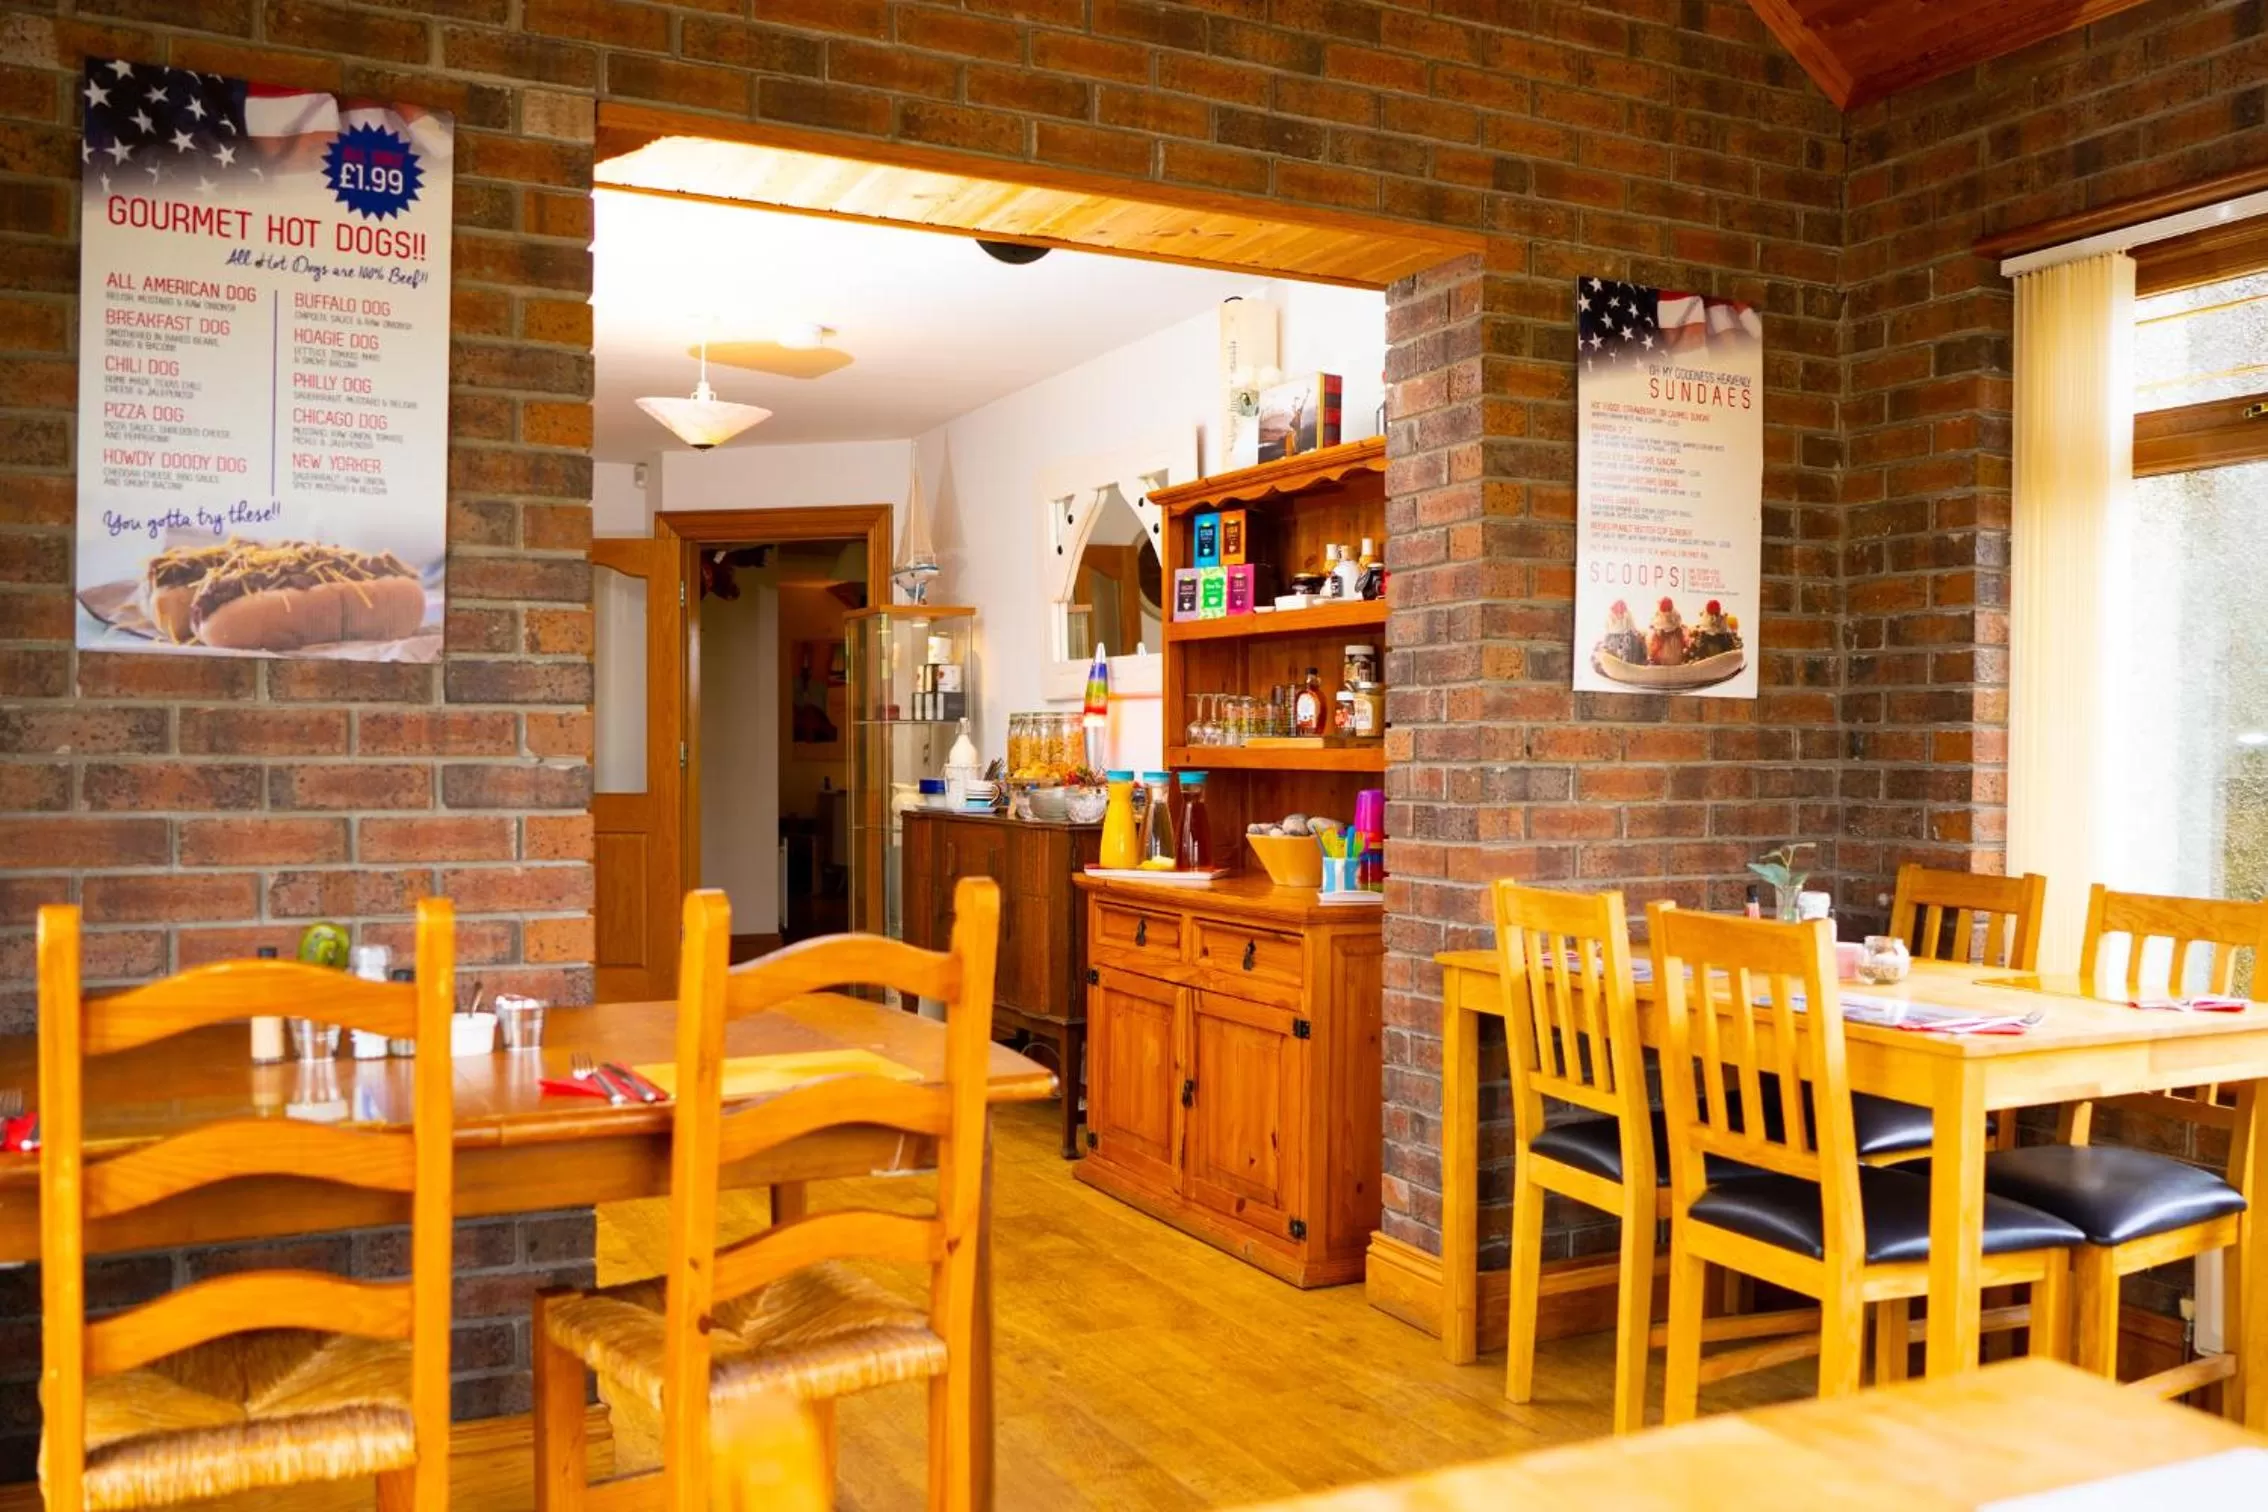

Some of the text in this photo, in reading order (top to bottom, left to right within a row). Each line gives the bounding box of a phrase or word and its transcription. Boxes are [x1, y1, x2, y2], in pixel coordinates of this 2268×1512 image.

[339, 162, 404, 195] £1.99
[108, 195, 427, 261] GOURMET HOT DOGS!!
[225, 248, 252, 266] All
[254, 253, 287, 272] Hot
[292, 255, 327, 283] Dogs
[332, 267, 355, 279] are
[358, 266, 385, 281] 100%
[106, 272, 257, 302] ALL AMERICAN DOG
[295, 292, 391, 316] BUFFALO DOG
[105, 308, 231, 336] BREAKFAST DOG
[294, 328, 379, 350] HOAGIE DOG
[104, 355, 180, 377] CHILI DOG
[1662, 366, 1673, 377] MY
[294, 372, 372, 394] PHILLY DOG
[1650, 378, 1752, 409] SUNDAES
[104, 402, 184, 422] PIZZA DOG
[293, 407, 388, 430] CHICAGO DOG
[104, 448, 247, 473] HOWDY DOODY DOG
[292, 453, 382, 474] NEW YORKER
[103, 500, 281, 539] You gotta try these!!
[1590, 561, 1680, 587] SCOOPS
